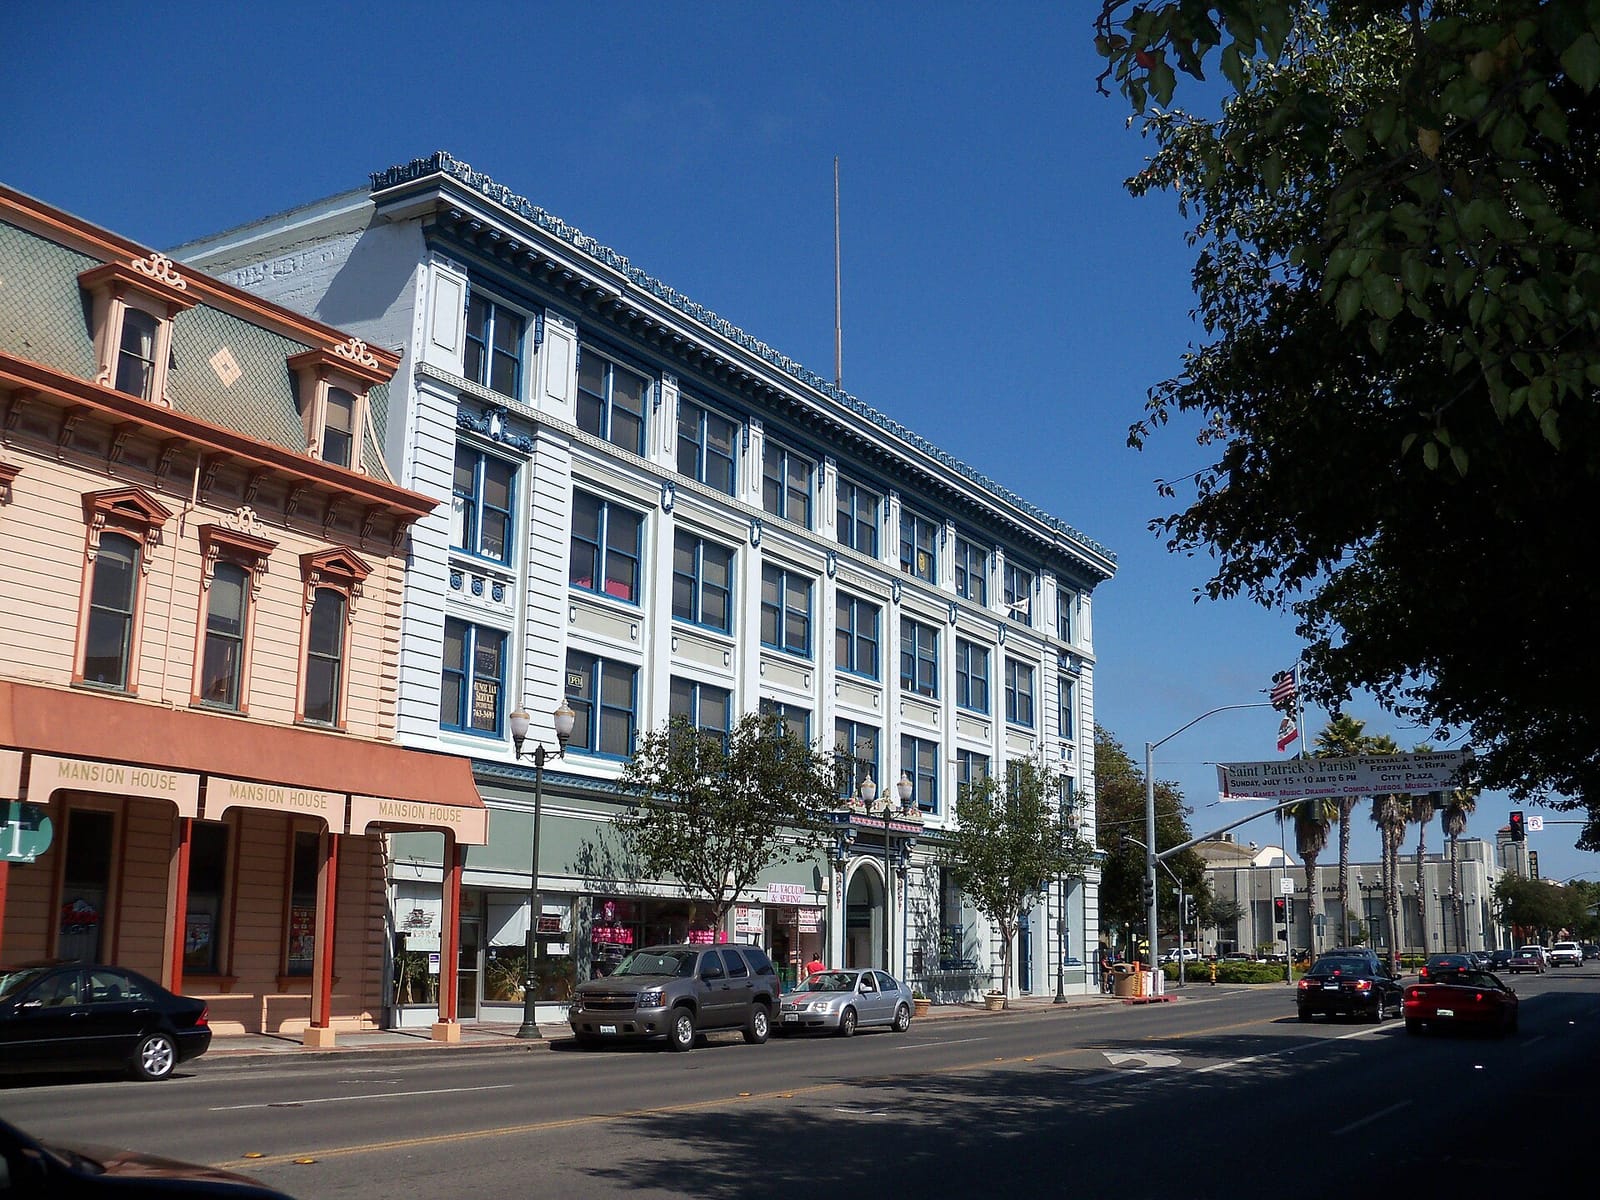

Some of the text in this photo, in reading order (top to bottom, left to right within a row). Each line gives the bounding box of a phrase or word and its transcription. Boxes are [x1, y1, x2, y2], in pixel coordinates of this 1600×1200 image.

[1413, 753, 1457, 761] DRAWING
[1229, 760, 1356, 778] Saint Patrick's Parish
[1370, 764, 1412, 772] FESTIVAL
[58, 761, 177, 791] MANSION HOUSE
[1381, 772, 1434, 781] CITY PLAZA
[1262, 778, 1281, 786] JULY
[229, 783, 328, 809] MANSION HOUSE
[378, 801, 462, 823] MANSION HOUSE
[779, 895, 801, 903] SEWING
